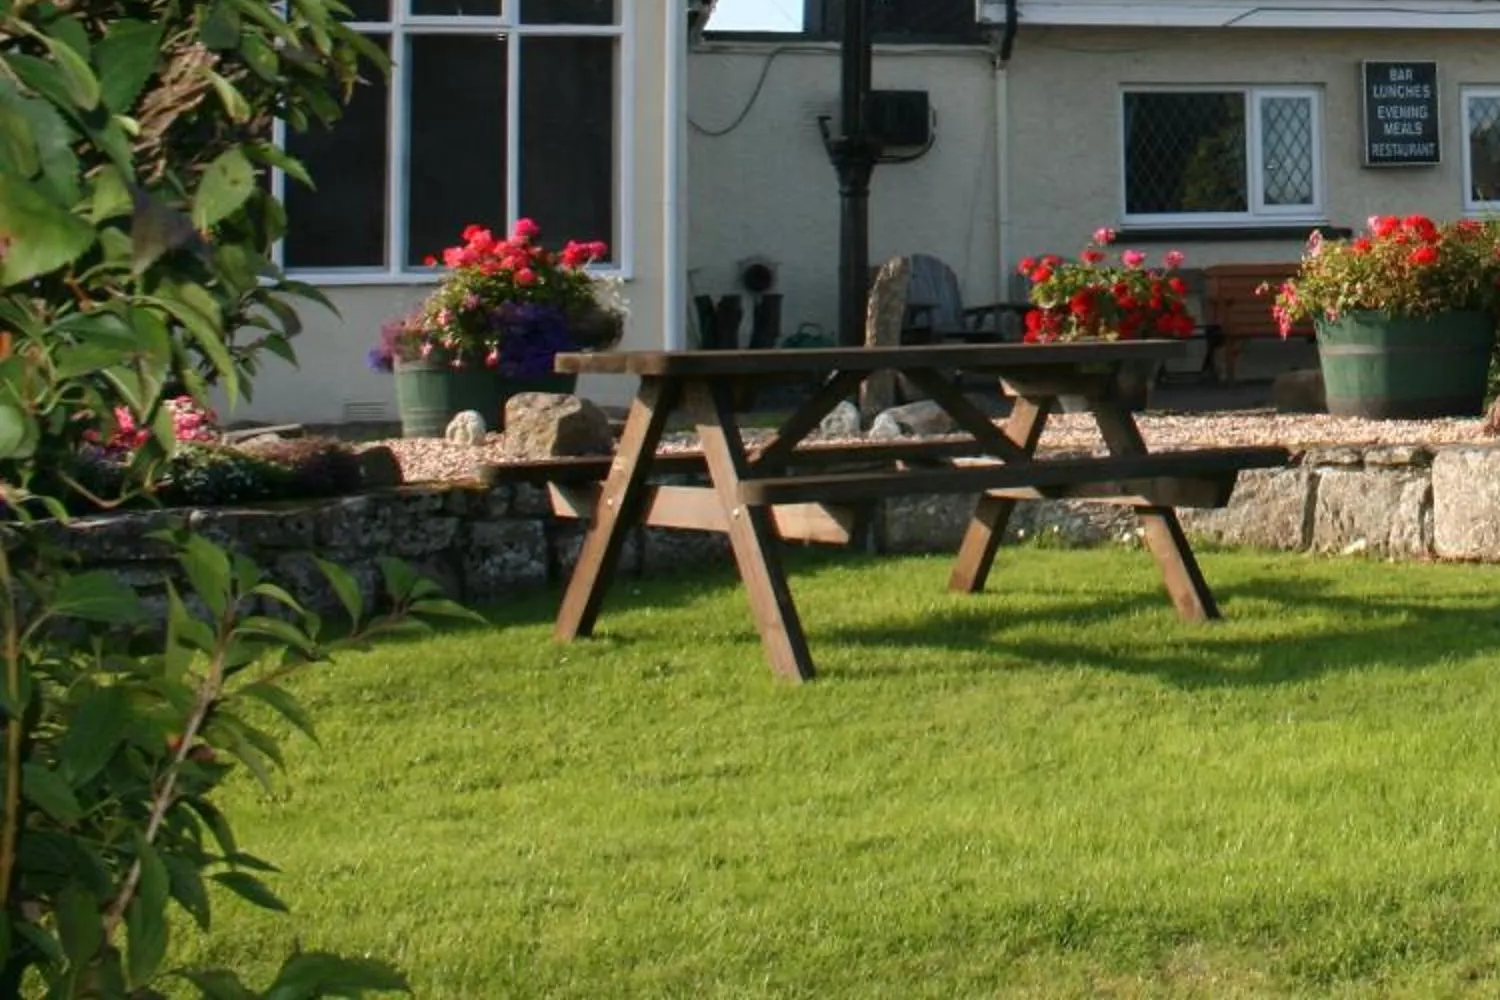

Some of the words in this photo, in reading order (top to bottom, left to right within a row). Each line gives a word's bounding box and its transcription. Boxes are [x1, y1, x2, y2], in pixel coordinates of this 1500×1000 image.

[1372, 84, 1432, 99] LUNCHES
[1377, 105, 1429, 119] EVENING
[1383, 121, 1424, 135] MEALS
